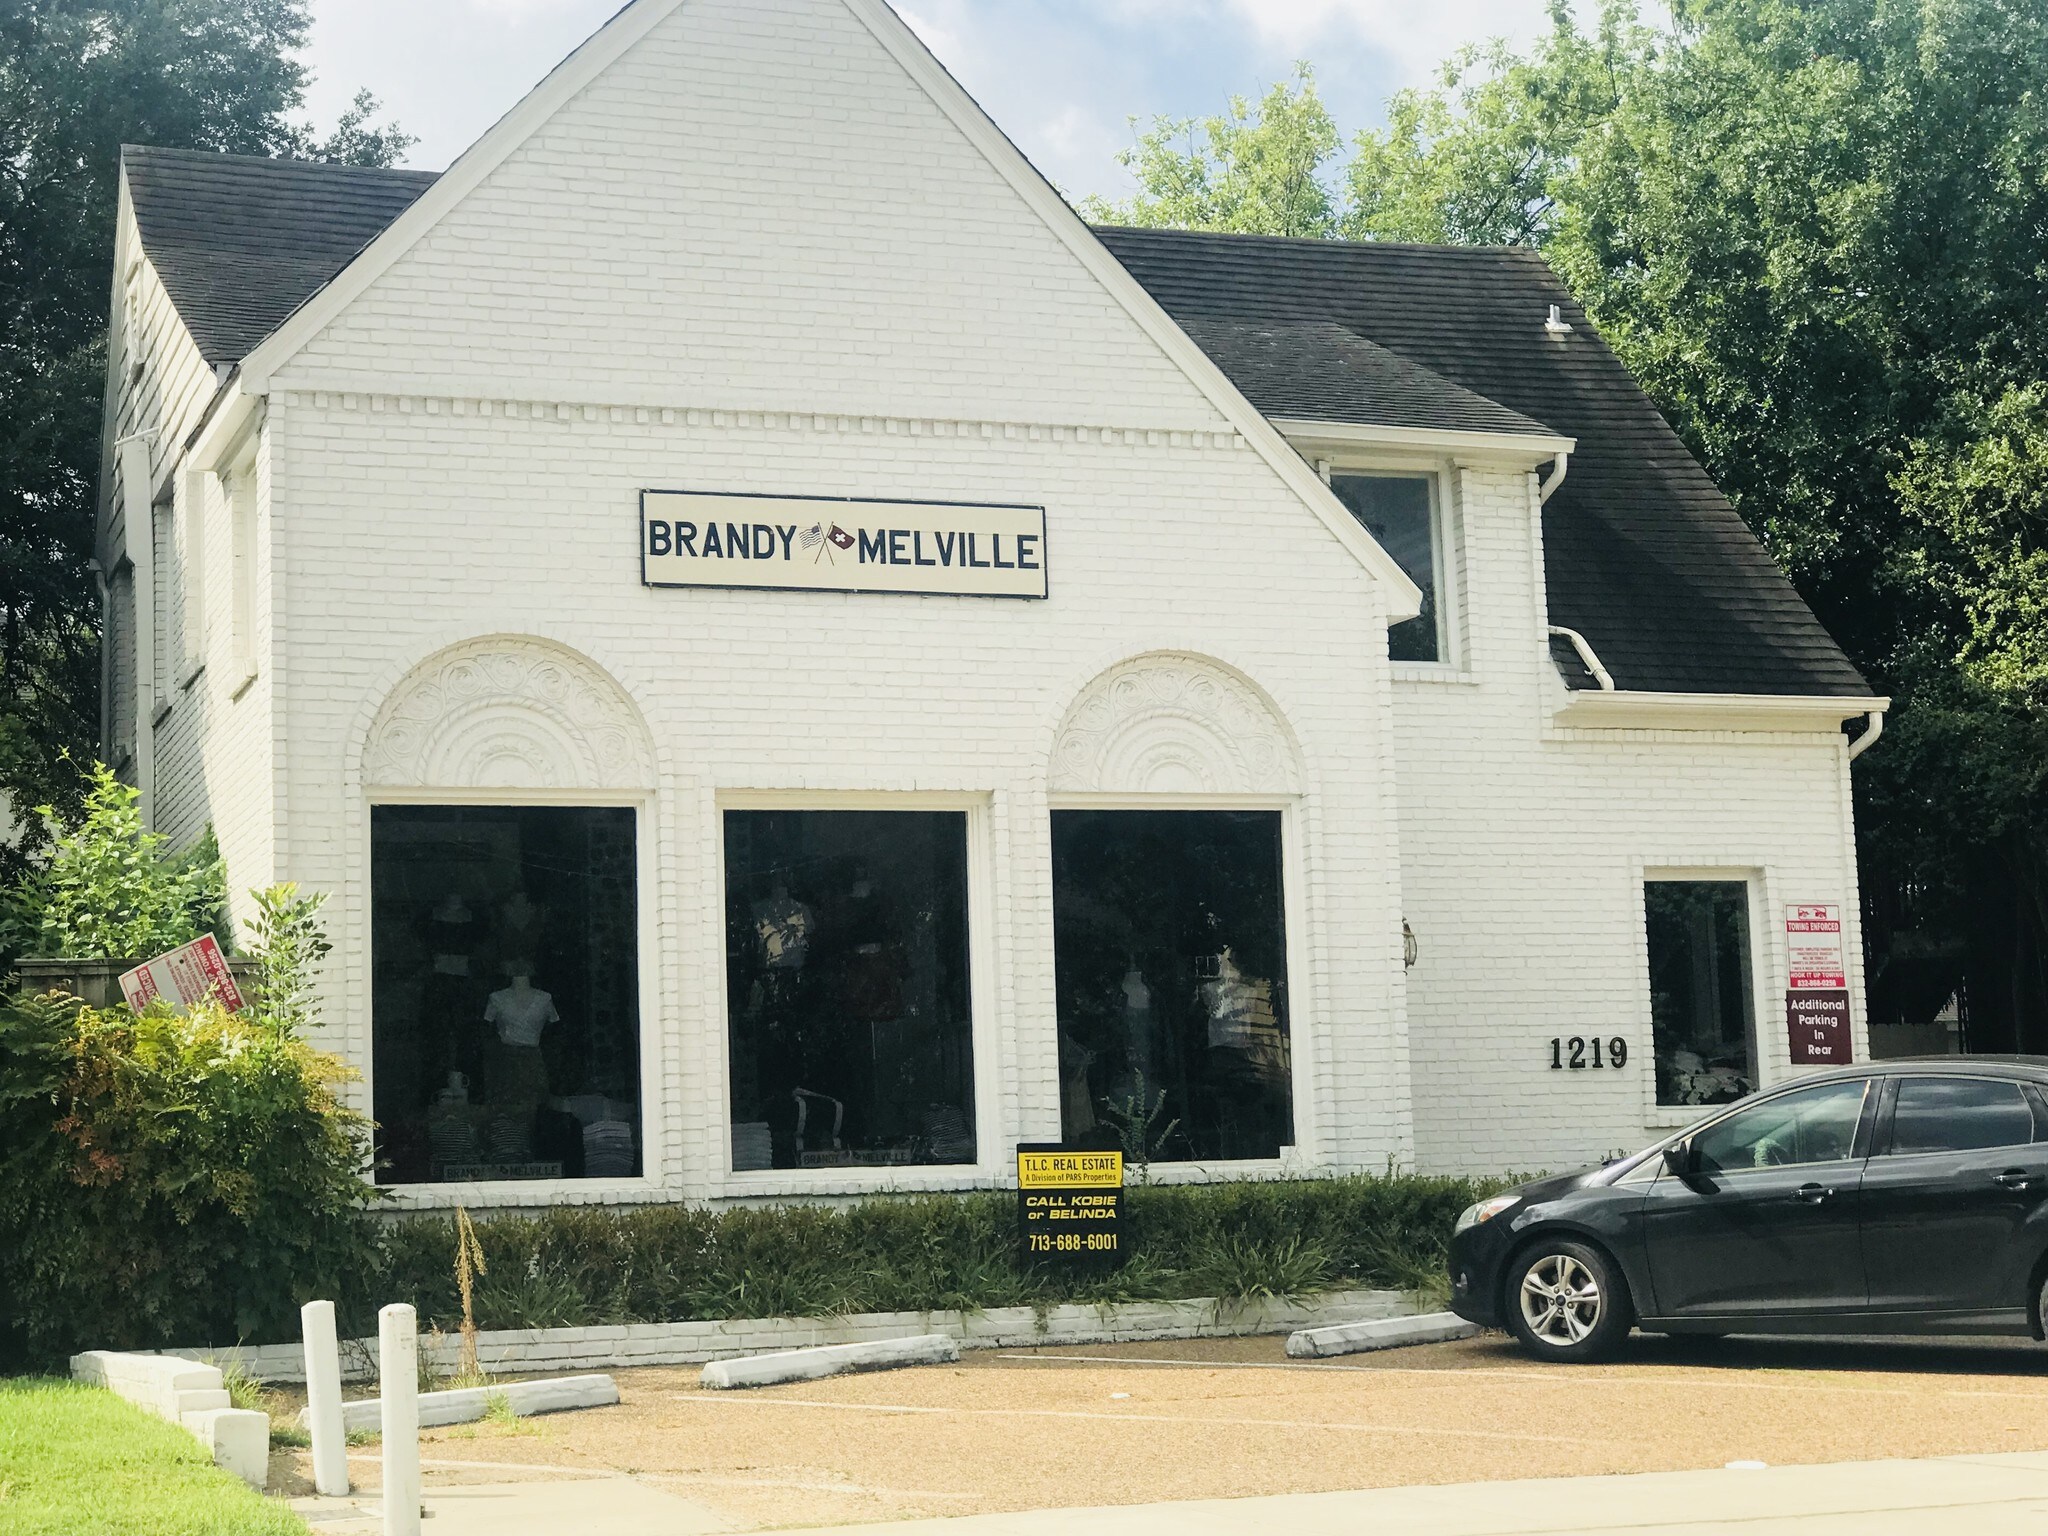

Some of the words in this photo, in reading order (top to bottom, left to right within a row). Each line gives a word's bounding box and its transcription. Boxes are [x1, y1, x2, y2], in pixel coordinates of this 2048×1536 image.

[649, 520, 797, 560] BRANDY
[858, 527, 1040, 569] MELVILLE
[1788, 922, 1809, 931] TOWING
[1810, 922, 1839, 931] ENFORCED
[194, 943, 211, 972] TOWING
[207, 948, 236, 1000] 832-868-0256
[1791, 999, 1845, 1010] Additional
[1798, 1014, 1838, 1027] Parking
[1814, 1029, 1825, 1040] In
[1551, 1036, 1627, 1069] 1219
[1807, 1044, 1832, 1055] Rear
[1025, 1159, 1050, 1171] T.L.C.
[1053, 1158, 1078, 1170] REAL
[1082, 1158, 1116, 1170] ESTATE
[510, 1165, 559, 1177] MELVILLE
[1057, 1173, 1064, 1181] of
[1083, 1173, 1116, 1182] Properties
[1026, 1196, 1066, 1206] CALL
[1071, 1195, 1117, 1206] KOBIE
[1049, 1208, 1117, 1219] BELINDA
[1029, 1234, 1117, 1251] 713-688-6001
